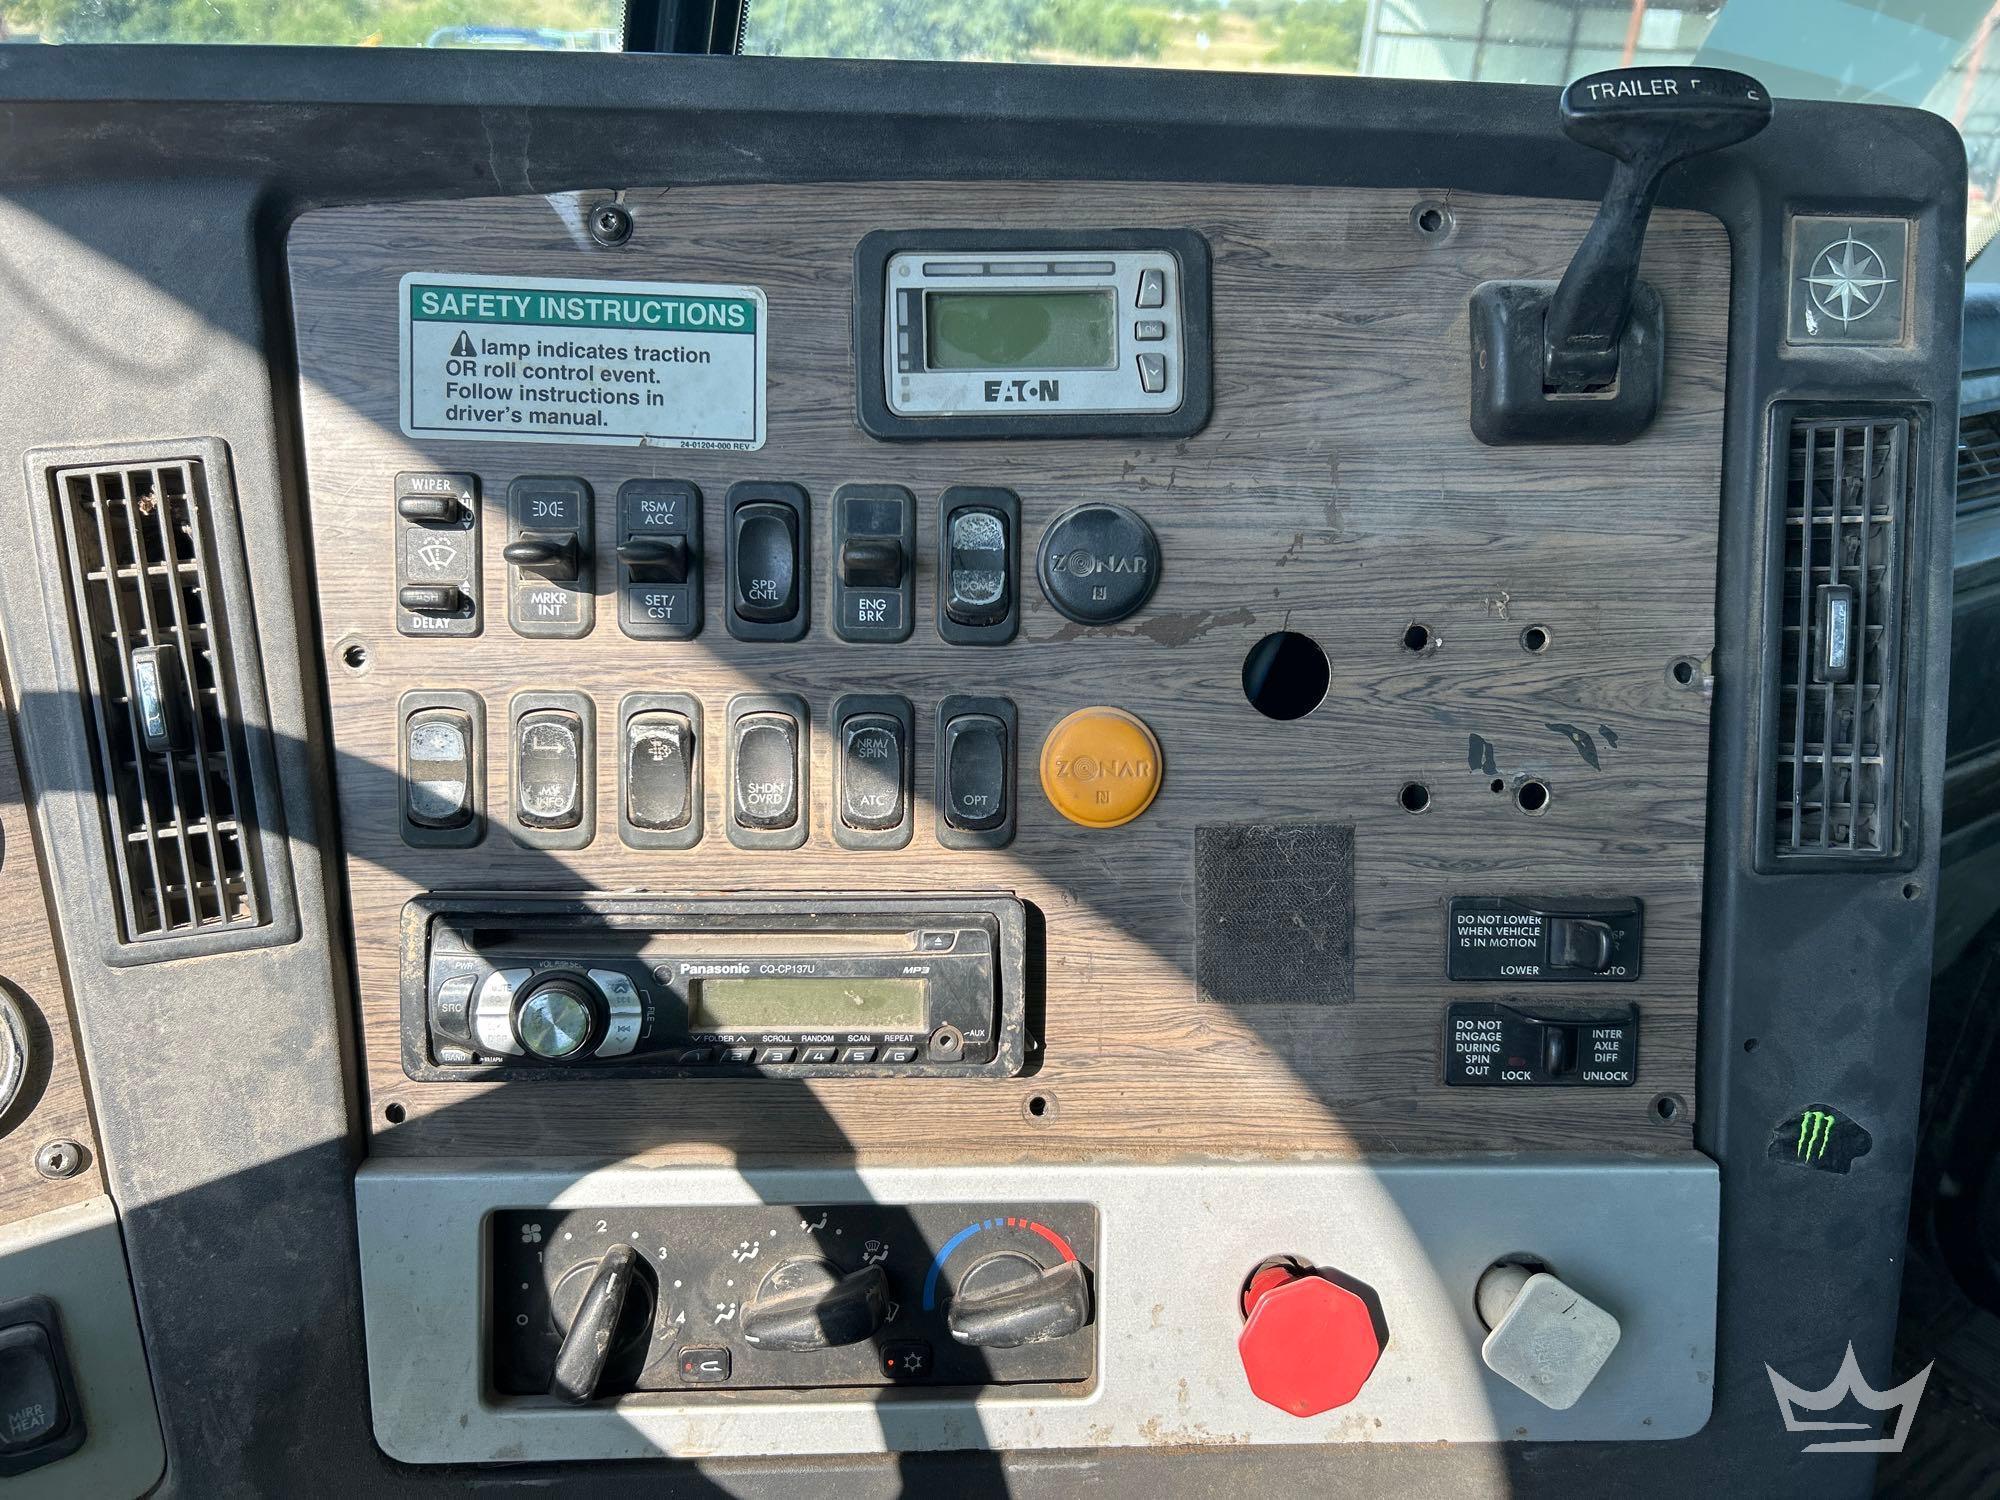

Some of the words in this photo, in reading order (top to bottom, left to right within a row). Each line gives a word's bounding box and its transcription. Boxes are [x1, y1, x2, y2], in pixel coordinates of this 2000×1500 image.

[1587, 79, 1679, 101] TRAILER
[421, 292, 531, 317] SAFETY
[539, 297, 745, 327] INSTRUCTIONS
[1144, 325, 1157, 334] OK
[482, 338, 530, 360] lamp
[538, 341, 628, 361] indicates
[635, 344, 711, 364] traction
[446, 360, 477, 378] OR
[484, 361, 516, 379] roll
[523, 363, 594, 382] control
[600, 369, 661, 384] event.
[446, 383, 513, 401] Follow
[520, 384, 640, 406] instructions
[646, 389, 664, 406] in
[984, 380, 1060, 402] EATON
[446, 405, 522, 424] driver's
[529, 408, 608, 427] manual.
[680, 441, 732, 450] 24-01204-000
[733, 443, 750, 451] REV
[412, 478, 450, 490] WIPER
[641, 500, 676, 513] RSM/
[462, 511, 473, 521] LO
[645, 513, 674, 525] ACC
[1051, 549, 1148, 578] ZONAR
[752, 579, 777, 590] SPD
[531, 592, 568, 606] MRKR
[749, 589, 779, 600] CNTL
[645, 595, 675, 607] SET/
[859, 599, 887, 611] ENG
[538, 604, 562, 616] INT
[648, 607, 673, 620] CST
[859, 611, 884, 622] BRK
[413, 617, 450, 629] DELAY
[857, 738, 889, 750] NRM/
[859, 747, 889, 759] SPIN
[1055, 754, 1152, 783] ZONAR
[748, 783, 784, 794] SHDN
[748, 793, 782, 804] OVRD
[860, 795, 885, 806] ATC
[963, 795, 988, 806] OPT
[1457, 915, 1474, 925] DO
[1477, 915, 1501, 925] NOT
[1504, 915, 1542, 925] LOWER
[1458, 927, 1492, 936] WHEN
[1496, 927, 1541, 936] VEHICLE
[1461, 938, 1471, 947] IS
[1474, 938, 1486, 947] IN
[1489, 938, 1537, 948] MOTION
[455, 962, 473, 970] PWR
[680, 963, 750, 975] Panasonic
[760, 964, 815, 975] CQ-CP137U
[903, 966, 930, 975] MP3
[1500, 966, 1539, 975] LOWER
[1594, 966, 1626, 976] UTO
[442, 1003, 463, 1013] SRC
[1456, 1021, 1474, 1030] DO
[1477, 1021, 1502, 1030] NOT
[884, 1034, 914, 1043] REPEAT
[970, 1029, 986, 1037] AUX
[1455, 1032, 1502, 1041] ENGAGE
[1592, 1030, 1623, 1039] INTER
[704, 1035, 735, 1043] FOLDER
[762, 1035, 792, 1043] SCROLL
[801, 1035, 835, 1043] RANDOM
[848, 1035, 871, 1043] SCAN
[1456, 1043, 1500, 1052] DURING
[1594, 1042, 1619, 1050] AXLE
[731, 1052, 743, 1061] 2
[772, 1052, 783, 1061] 3
[813, 1052, 825, 1061] 4
[853, 1052, 865, 1061] 5
[1465, 1055, 1490, 1063] SPIN
[1594, 1053, 1618, 1062] DIFF
[1466, 1066, 1490, 1075] OUT
[1502, 1071, 1531, 1080] LOCK
[1583, 1071, 1628, 1081] UNLOCK
[596, 1220, 607, 1232] 2
[537, 1252, 543, 1263] 1
[659, 1247, 667, 1260] 3
[675, 1311, 686, 1324] 4
[10, 1414, 45, 1434] HEAT
